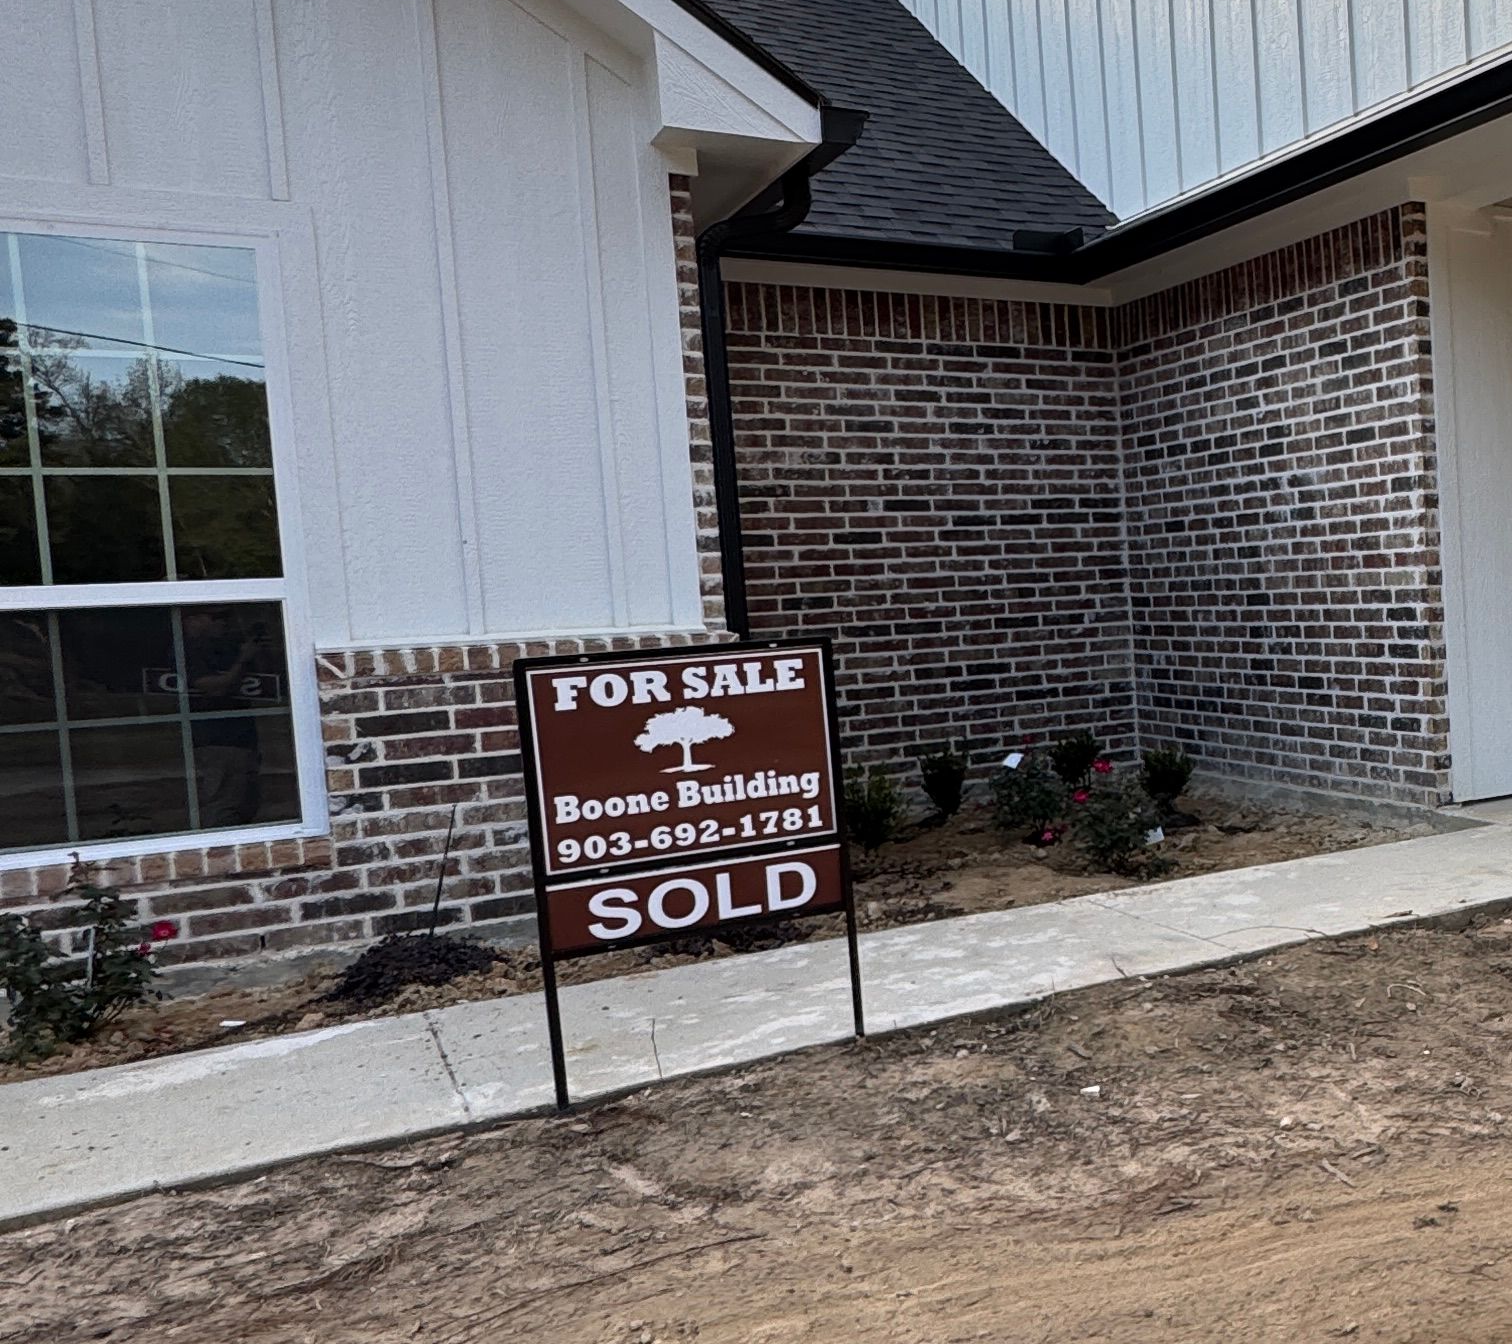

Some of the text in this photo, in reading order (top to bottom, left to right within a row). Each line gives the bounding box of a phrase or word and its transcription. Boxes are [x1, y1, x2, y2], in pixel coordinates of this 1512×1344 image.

[552, 658, 805, 711] FOR SALE
[553, 769, 820, 825] Boone Building
[557, 804, 823, 864] 903-692-1781
[588, 861, 817, 940] SOLD
